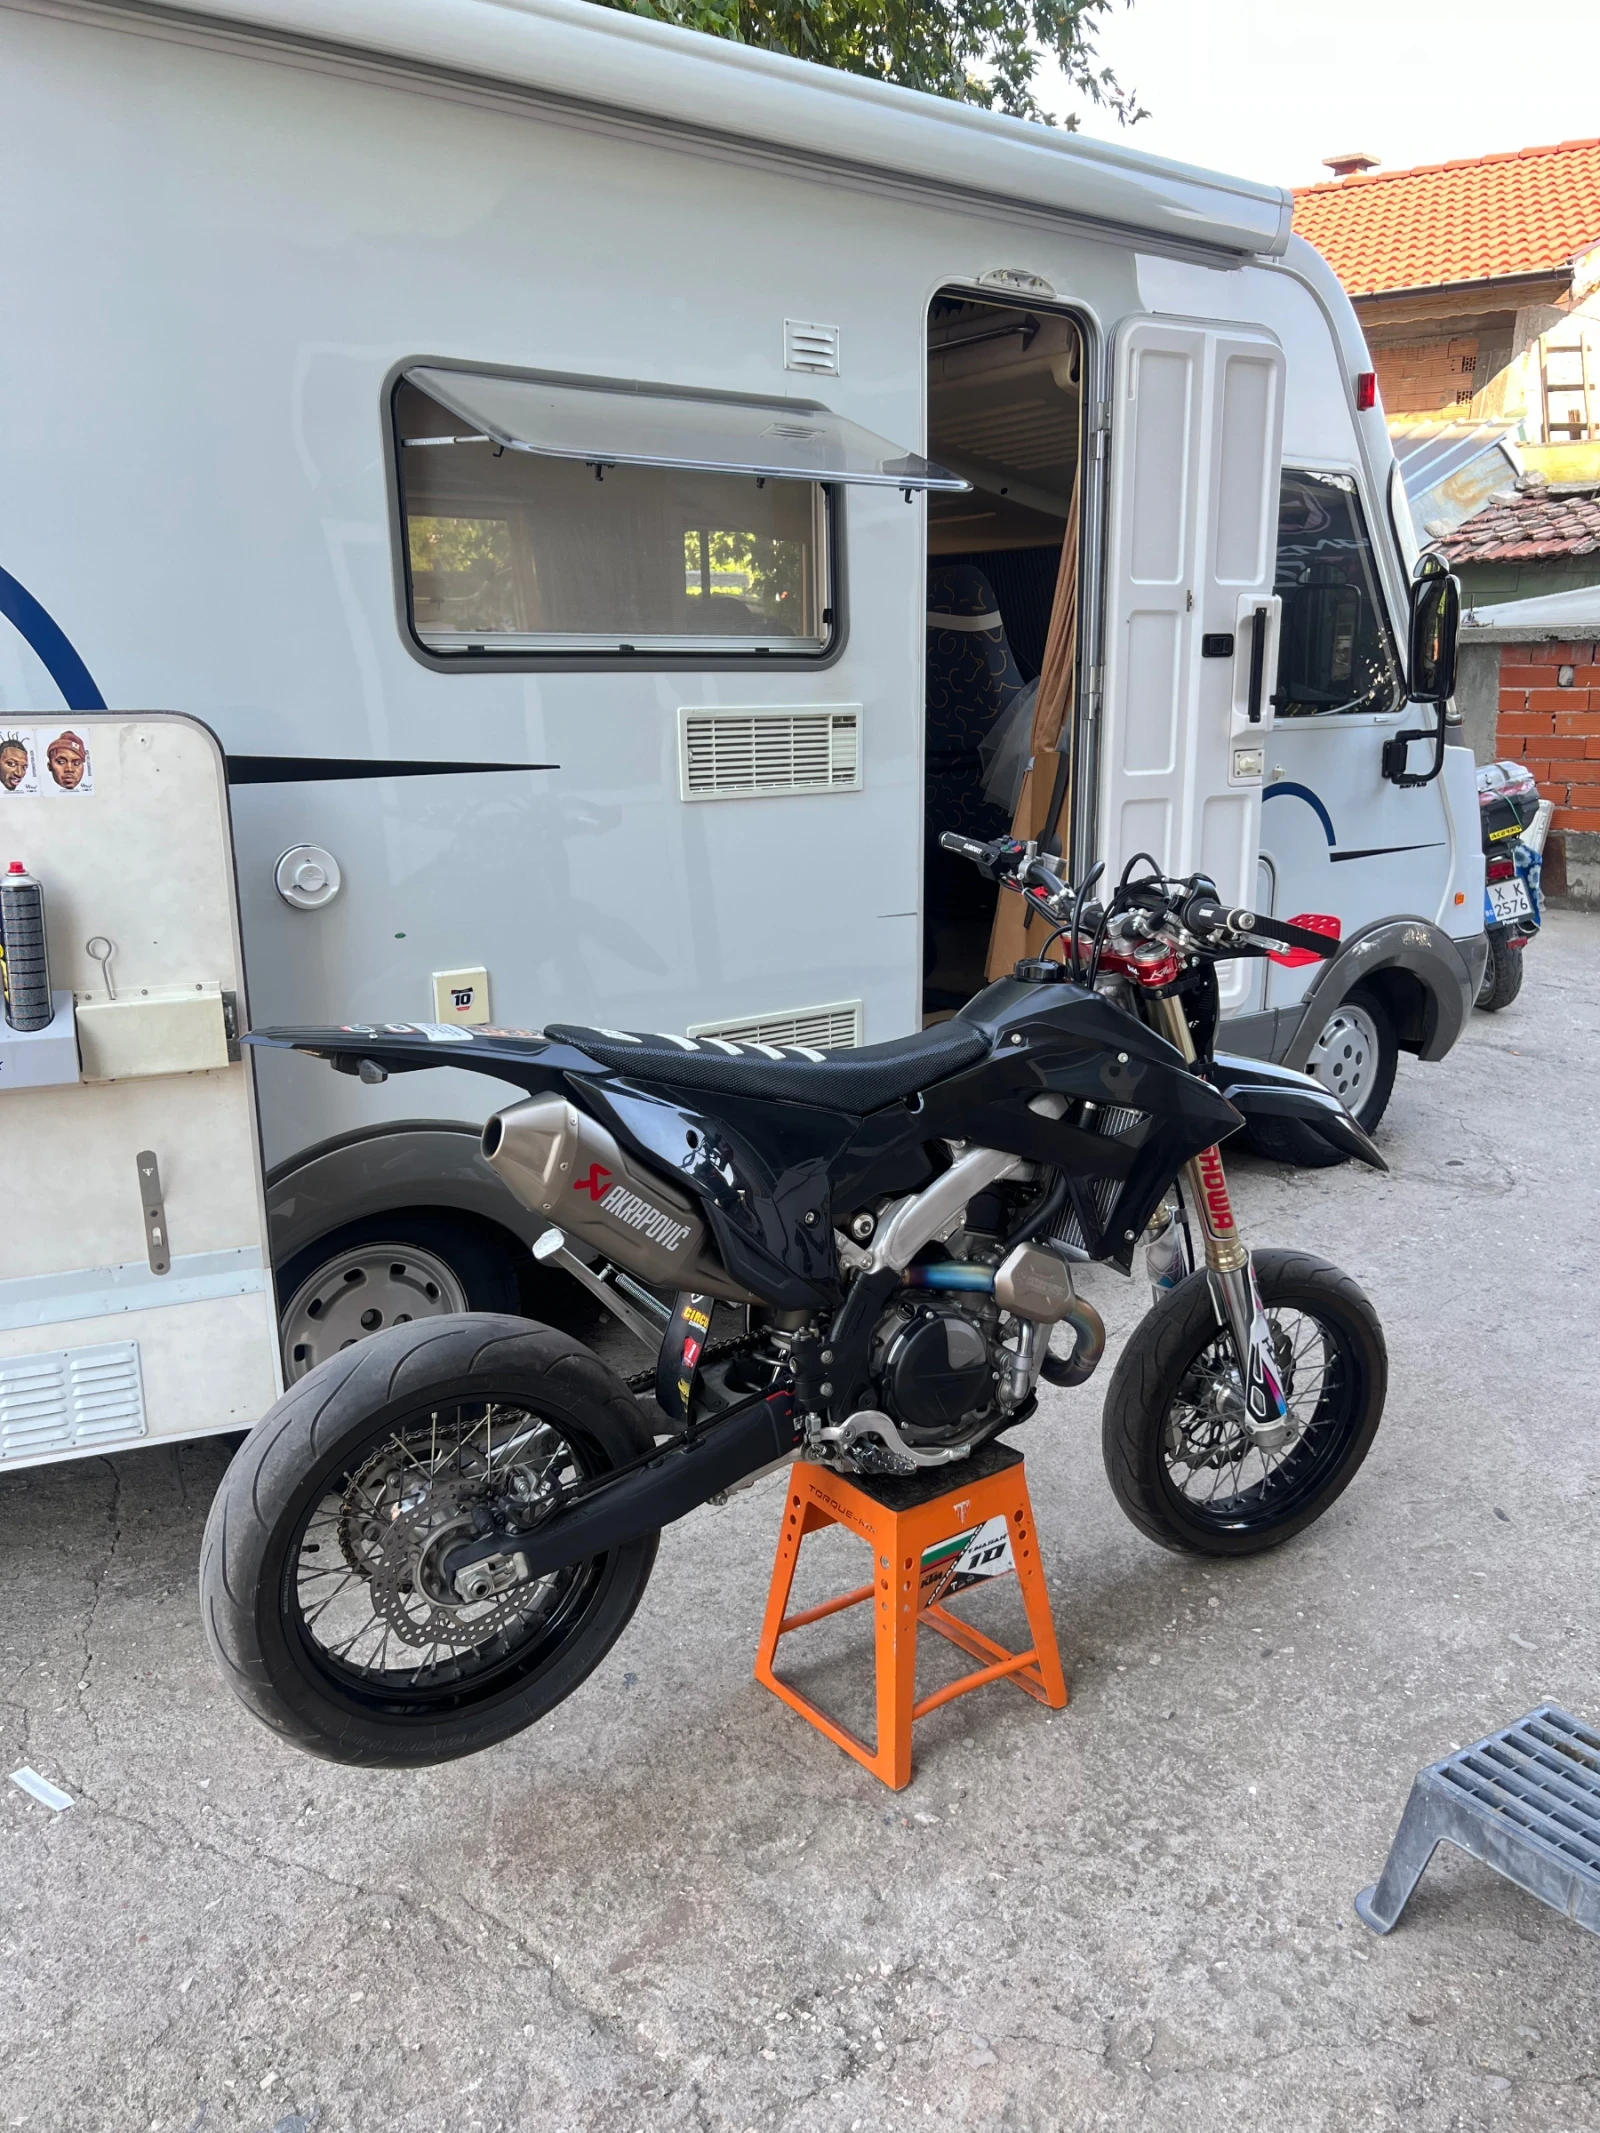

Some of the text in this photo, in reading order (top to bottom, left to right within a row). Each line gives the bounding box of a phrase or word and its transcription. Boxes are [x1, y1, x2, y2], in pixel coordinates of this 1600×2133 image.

[1495, 883, 1524, 901] X K
[1494, 898, 1528, 918] 2576
[454, 993, 471, 1006] 10
[967, 1542, 1007, 1571] 10
